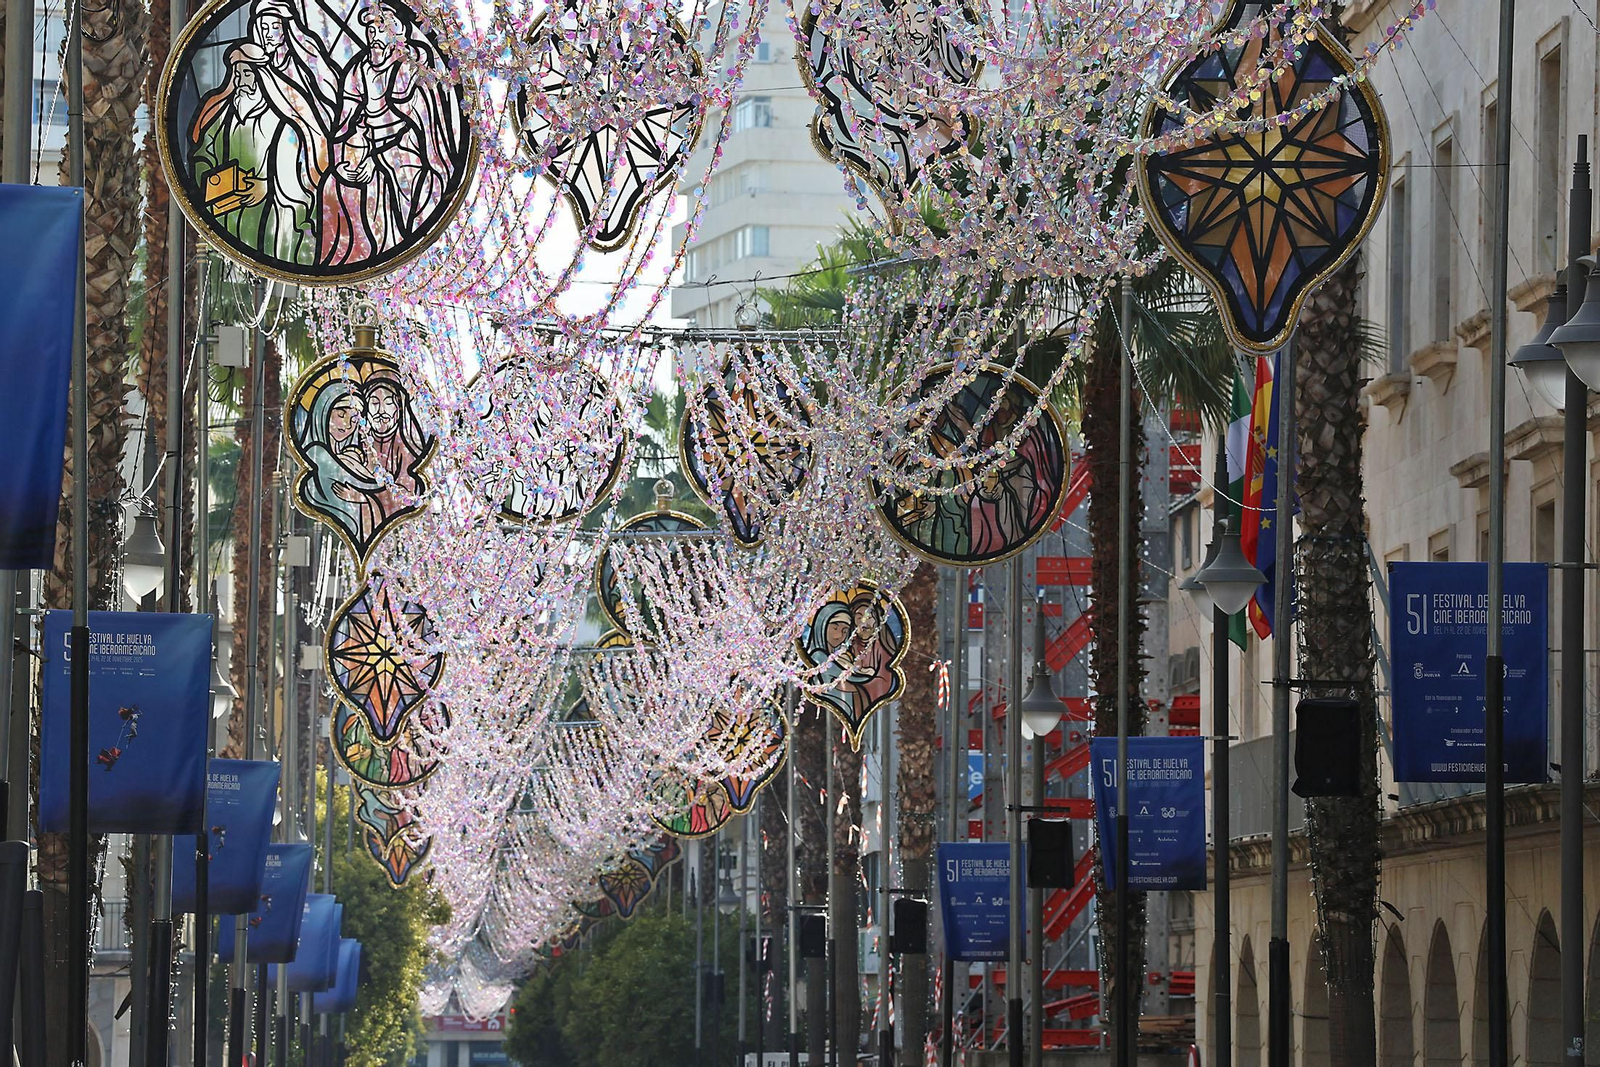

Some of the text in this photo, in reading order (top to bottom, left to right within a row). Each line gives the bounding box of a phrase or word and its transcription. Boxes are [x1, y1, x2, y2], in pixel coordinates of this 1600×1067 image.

[1434, 594, 1526, 609] FESTIVAL DE ELVA
[1407, 594, 1427, 634] 51
[1434, 610, 1532, 624] CINE IBEROARICANO
[89, 632, 152, 645] ESTIVAL DE HUELVA
[64, 633, 72, 662] 5
[89, 643, 156, 656] NE IBEROAMERICANO
[1153, 759, 1162, 769] DE
[1163, 759, 1188, 769] HUELVA
[1103, 759, 1117, 788] 51
[1137, 770, 1192, 780] IBEROAMERICANO
[947, 860, 959, 882] 51
[962, 860, 1010, 868] FESTIVAL DE HUELV
